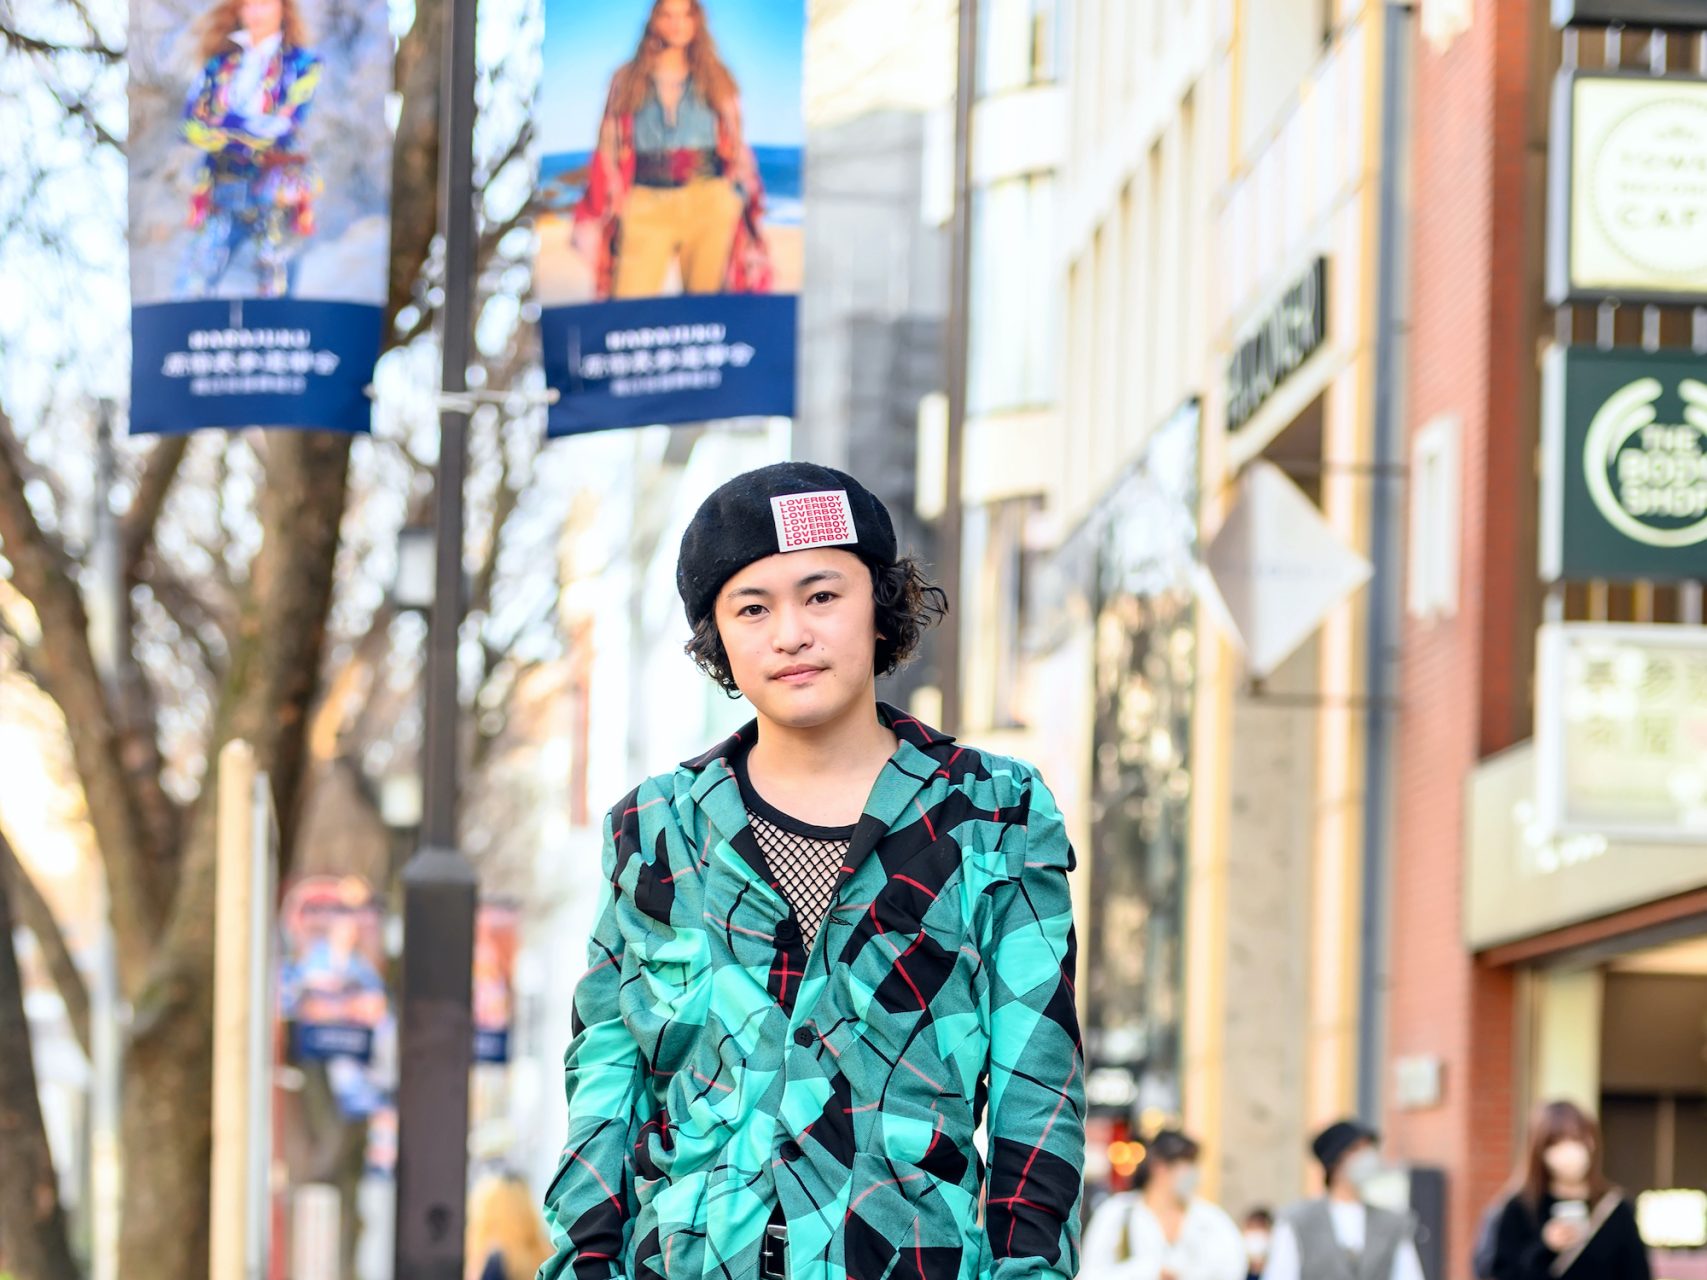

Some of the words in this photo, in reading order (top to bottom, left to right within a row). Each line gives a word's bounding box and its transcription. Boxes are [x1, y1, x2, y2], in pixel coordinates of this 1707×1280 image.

[779, 495, 841, 507] LOVERBOY
[781, 501, 842, 513] LOVERBOY
[782, 508, 844, 520] LOVERBOY
[783, 514, 845, 526] LOVERBOY
[784, 520, 847, 533] LOVERBOY
[785, 527, 848, 539] LOVERBOY
[786, 533, 850, 547] LOVERBOY
